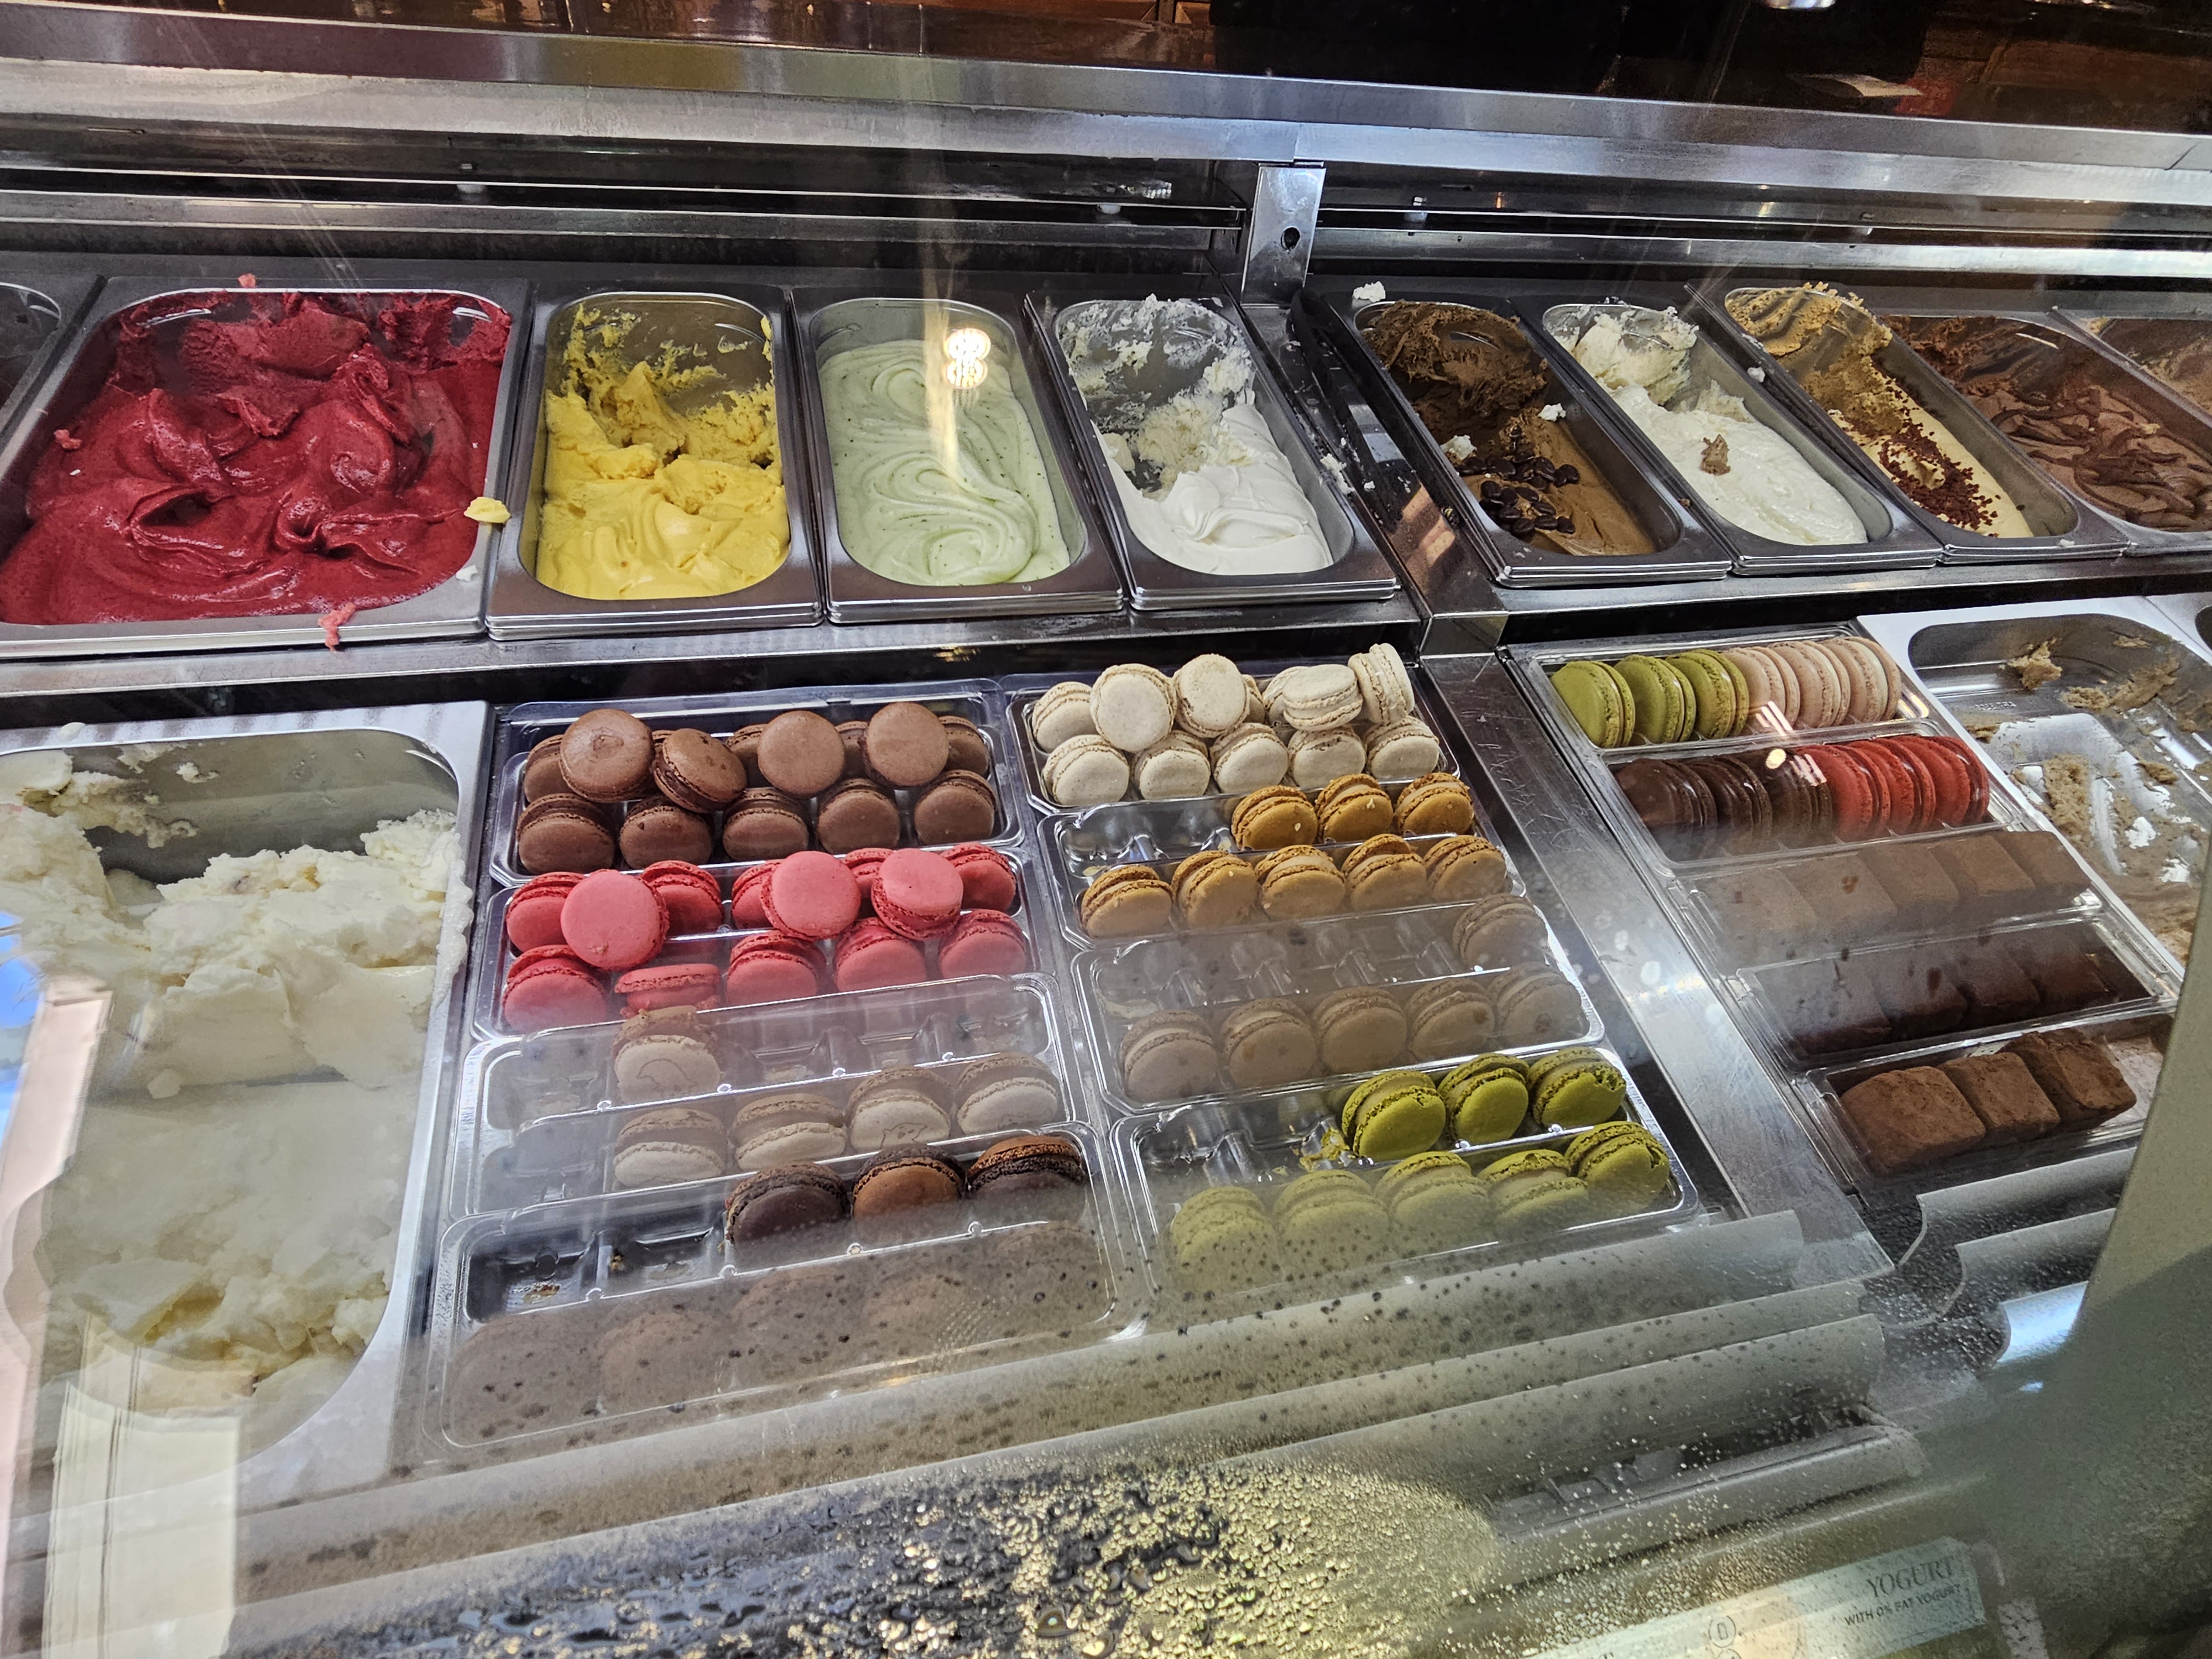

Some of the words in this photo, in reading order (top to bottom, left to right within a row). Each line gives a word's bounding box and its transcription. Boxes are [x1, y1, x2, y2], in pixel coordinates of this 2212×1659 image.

[1866, 1555, 1954, 1597] YOGURT
[1844, 1609, 1874, 1626] WITH
[1895, 1597, 1913, 1613] FAT
